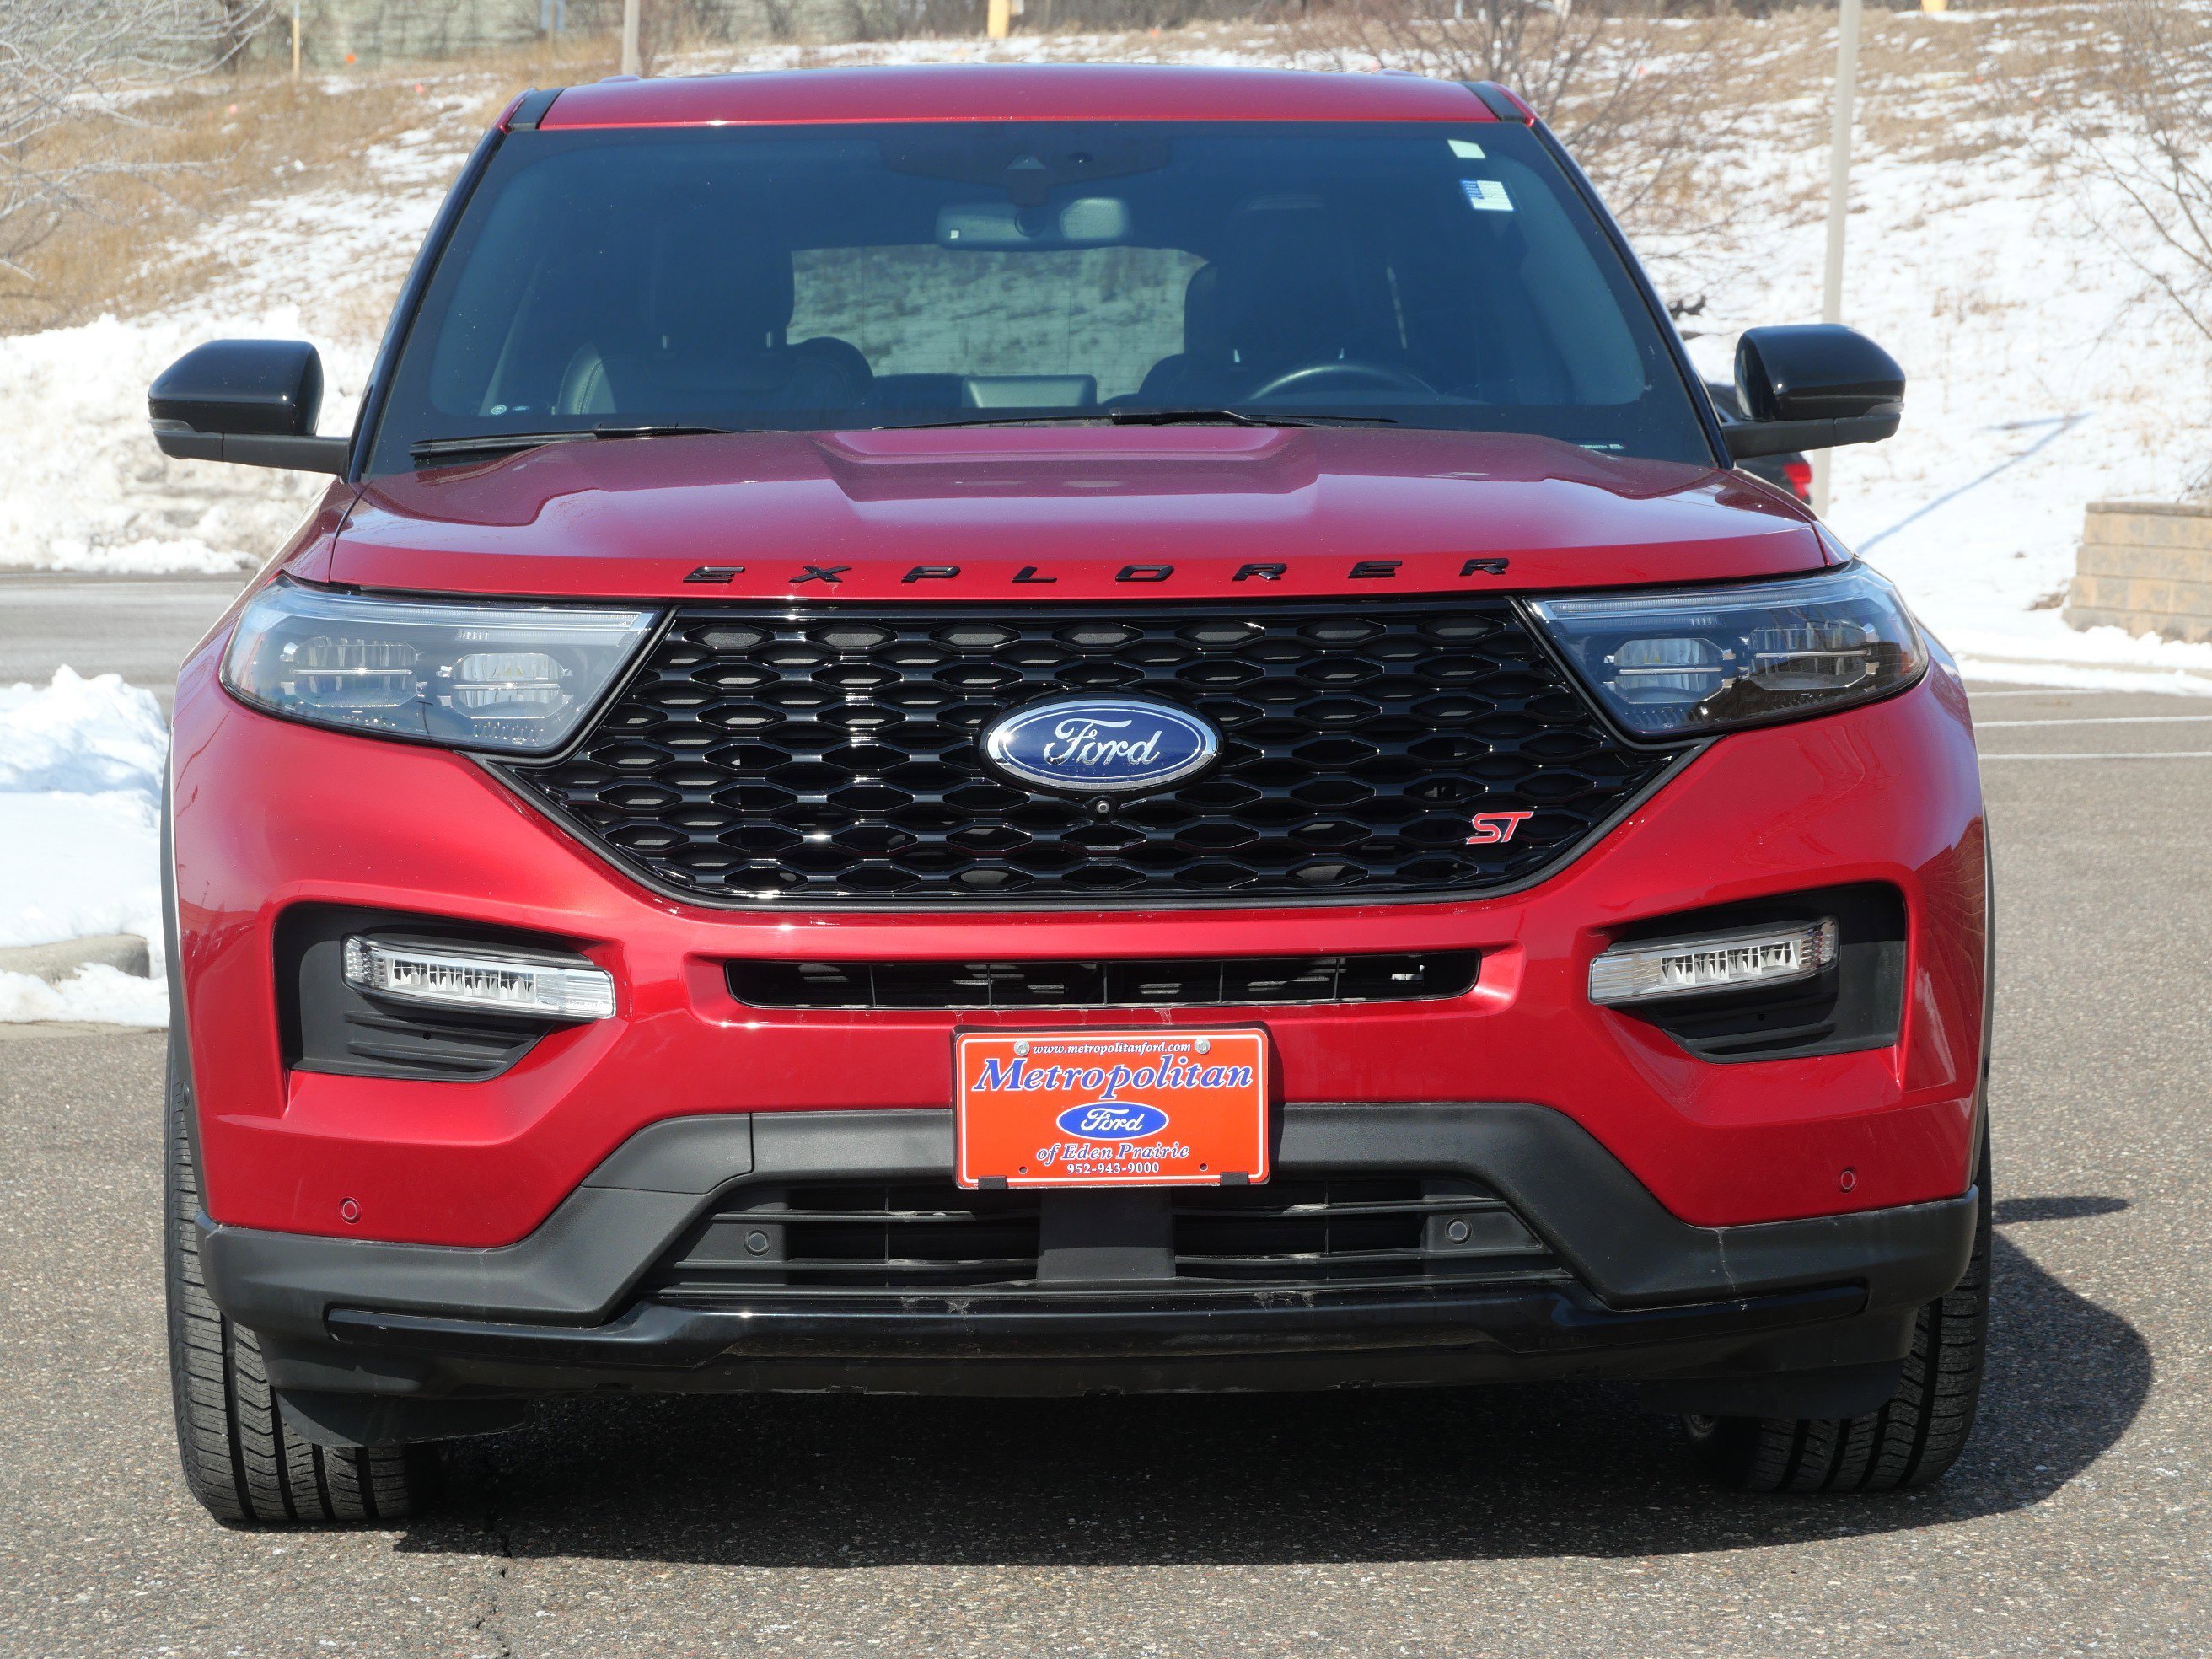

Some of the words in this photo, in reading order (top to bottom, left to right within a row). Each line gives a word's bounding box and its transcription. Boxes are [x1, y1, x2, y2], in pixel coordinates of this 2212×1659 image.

[684, 557, 1510, 583] EXPLORER
[1043, 717, 1162, 765] Ford
[1466, 811, 1534, 845] ST
[1033, 1042, 1191, 1055] www.metropolitanford.com
[971, 1054, 1253, 1101] Metropolitan
[1080, 1108, 1145, 1131] Ford
[1036, 1143, 1062, 1166] of
[1060, 1142, 1113, 1161] Eden
[1117, 1141, 1190, 1160] Prairie
[1066, 1162, 1161, 1175] 952-943-9000
